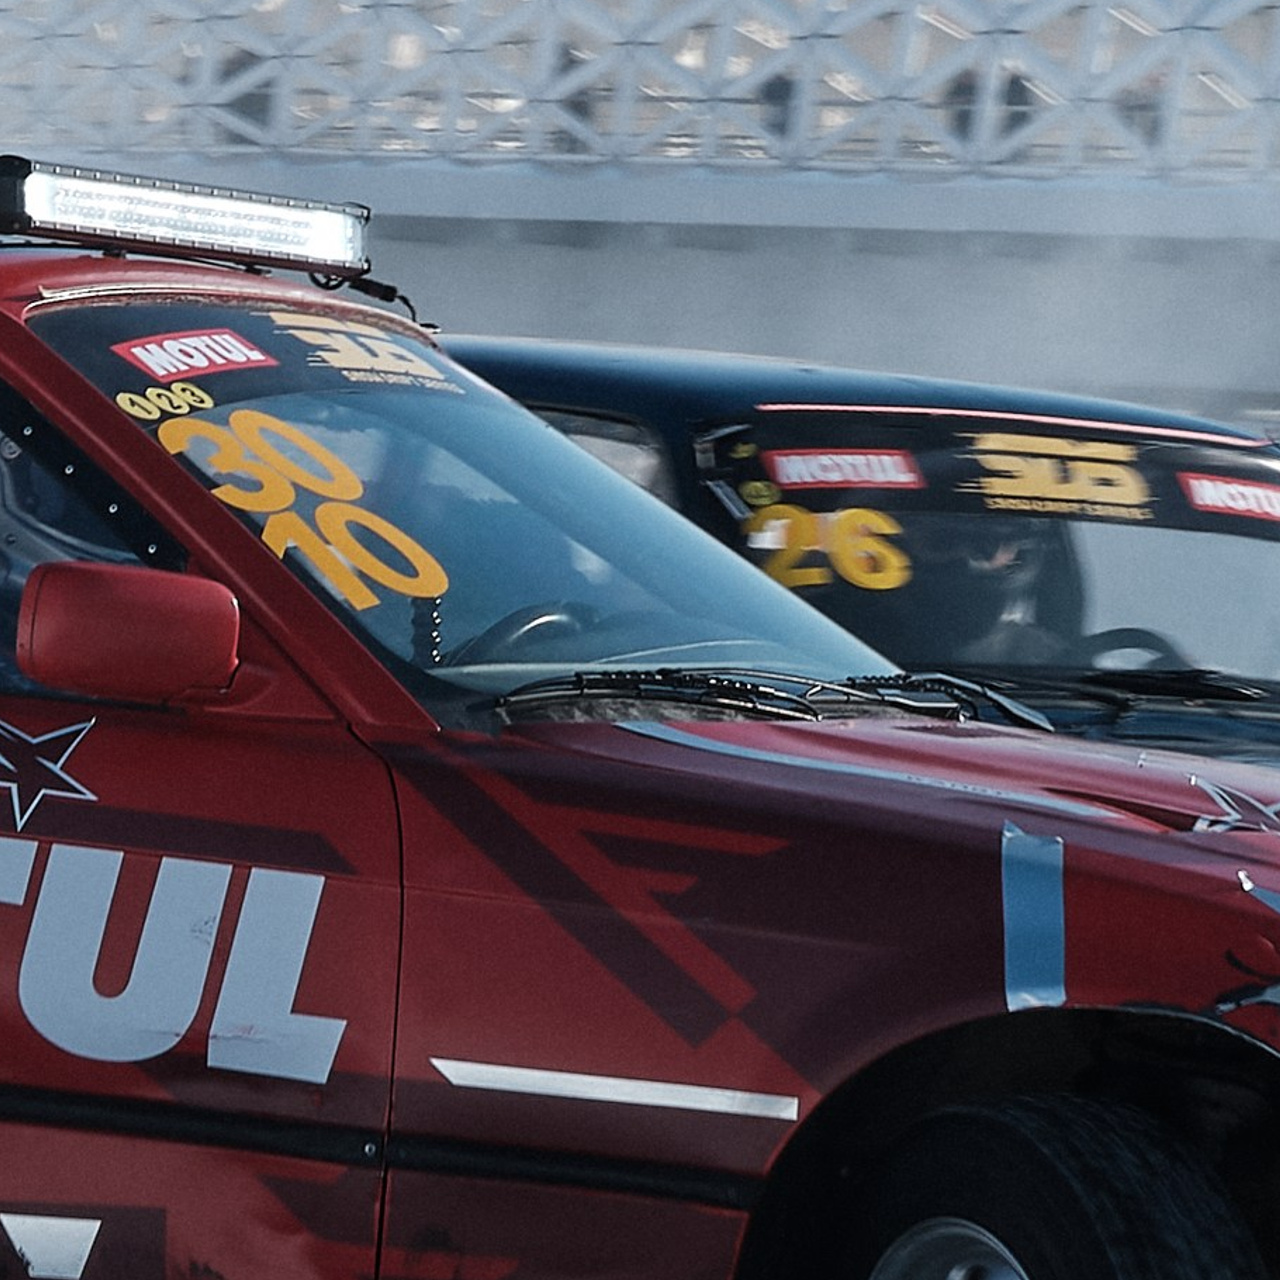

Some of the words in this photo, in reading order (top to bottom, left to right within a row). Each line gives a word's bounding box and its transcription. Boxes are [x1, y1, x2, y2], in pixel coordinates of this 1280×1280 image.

[130, 334, 266, 377] MOTUL
[158, 409, 363, 512] 30
[774, 454, 918, 484] MOTUL
[262, 501, 449, 610] 10
[742, 504, 913, 590] 26
